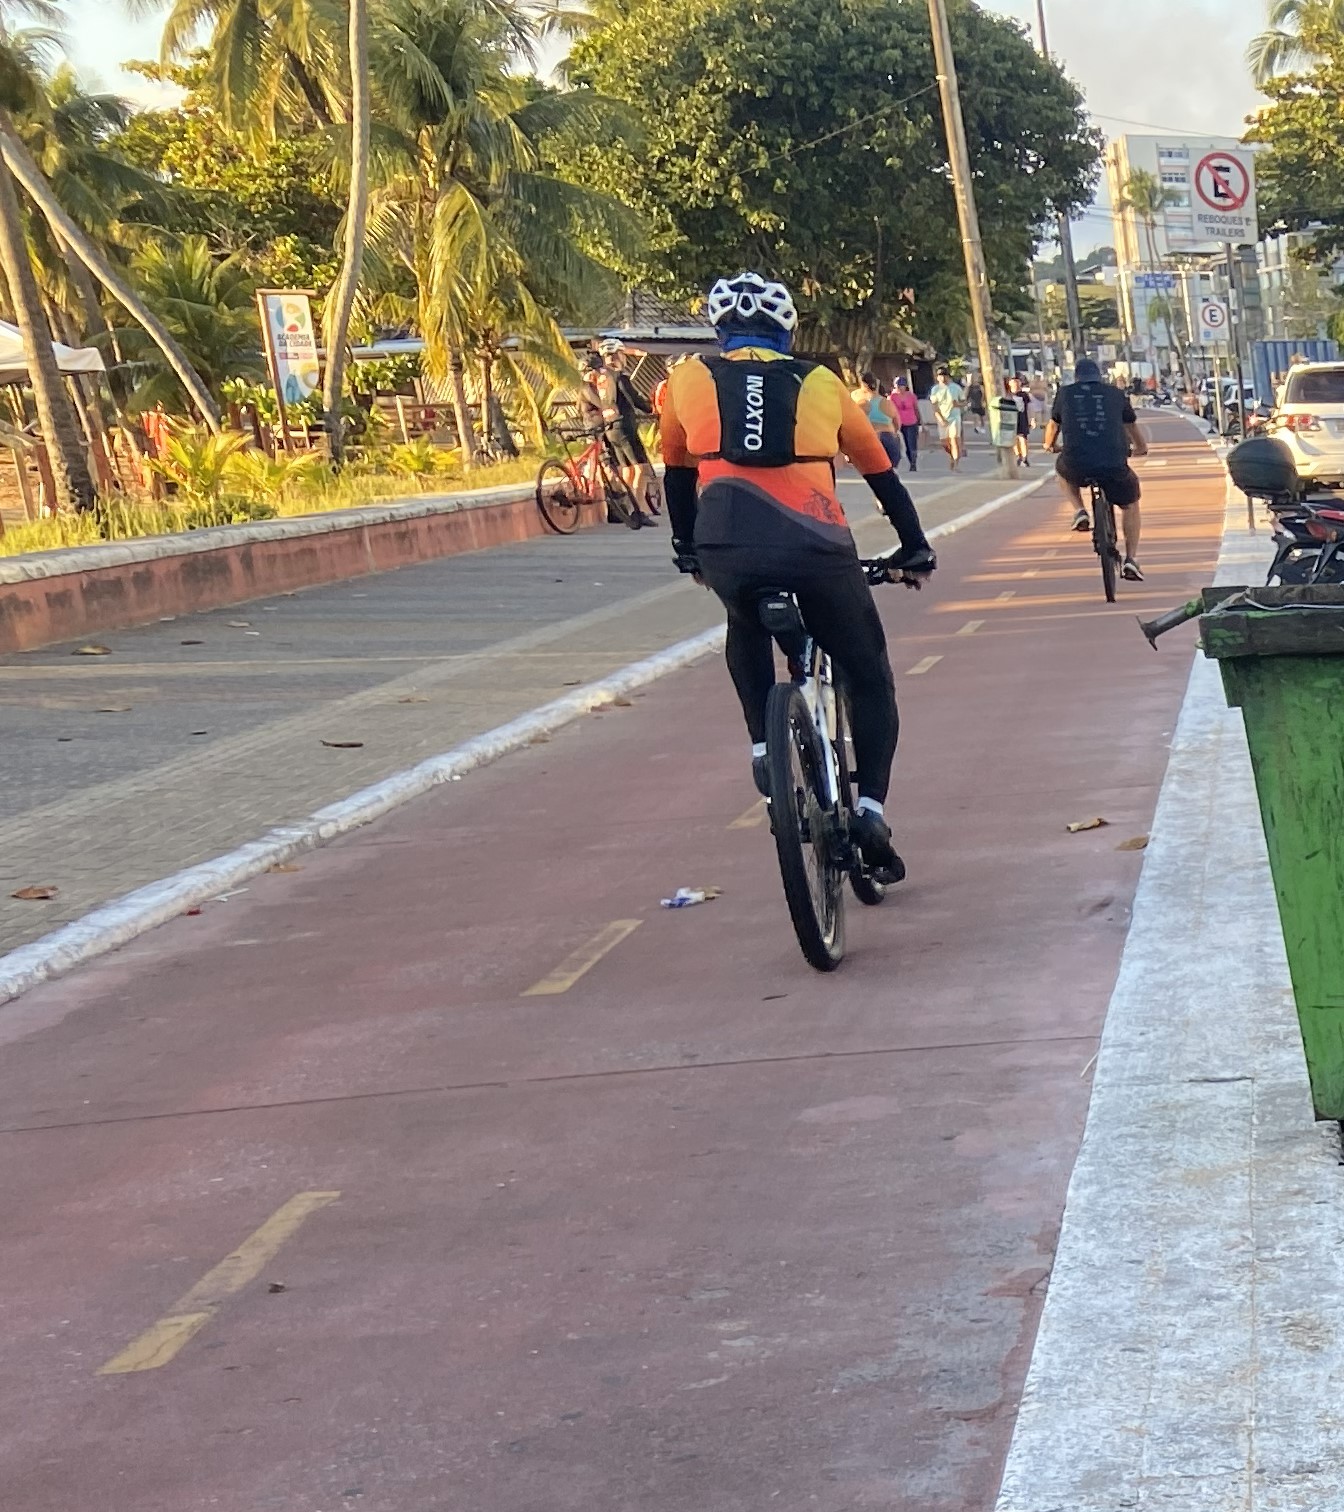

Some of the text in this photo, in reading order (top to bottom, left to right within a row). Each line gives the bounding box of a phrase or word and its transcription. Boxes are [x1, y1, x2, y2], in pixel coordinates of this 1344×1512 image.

[1197, 213, 1243, 226] REBOQUES
[1205, 226, 1246, 238] TRAILERS
[744, 375, 764, 451] INOXTO
